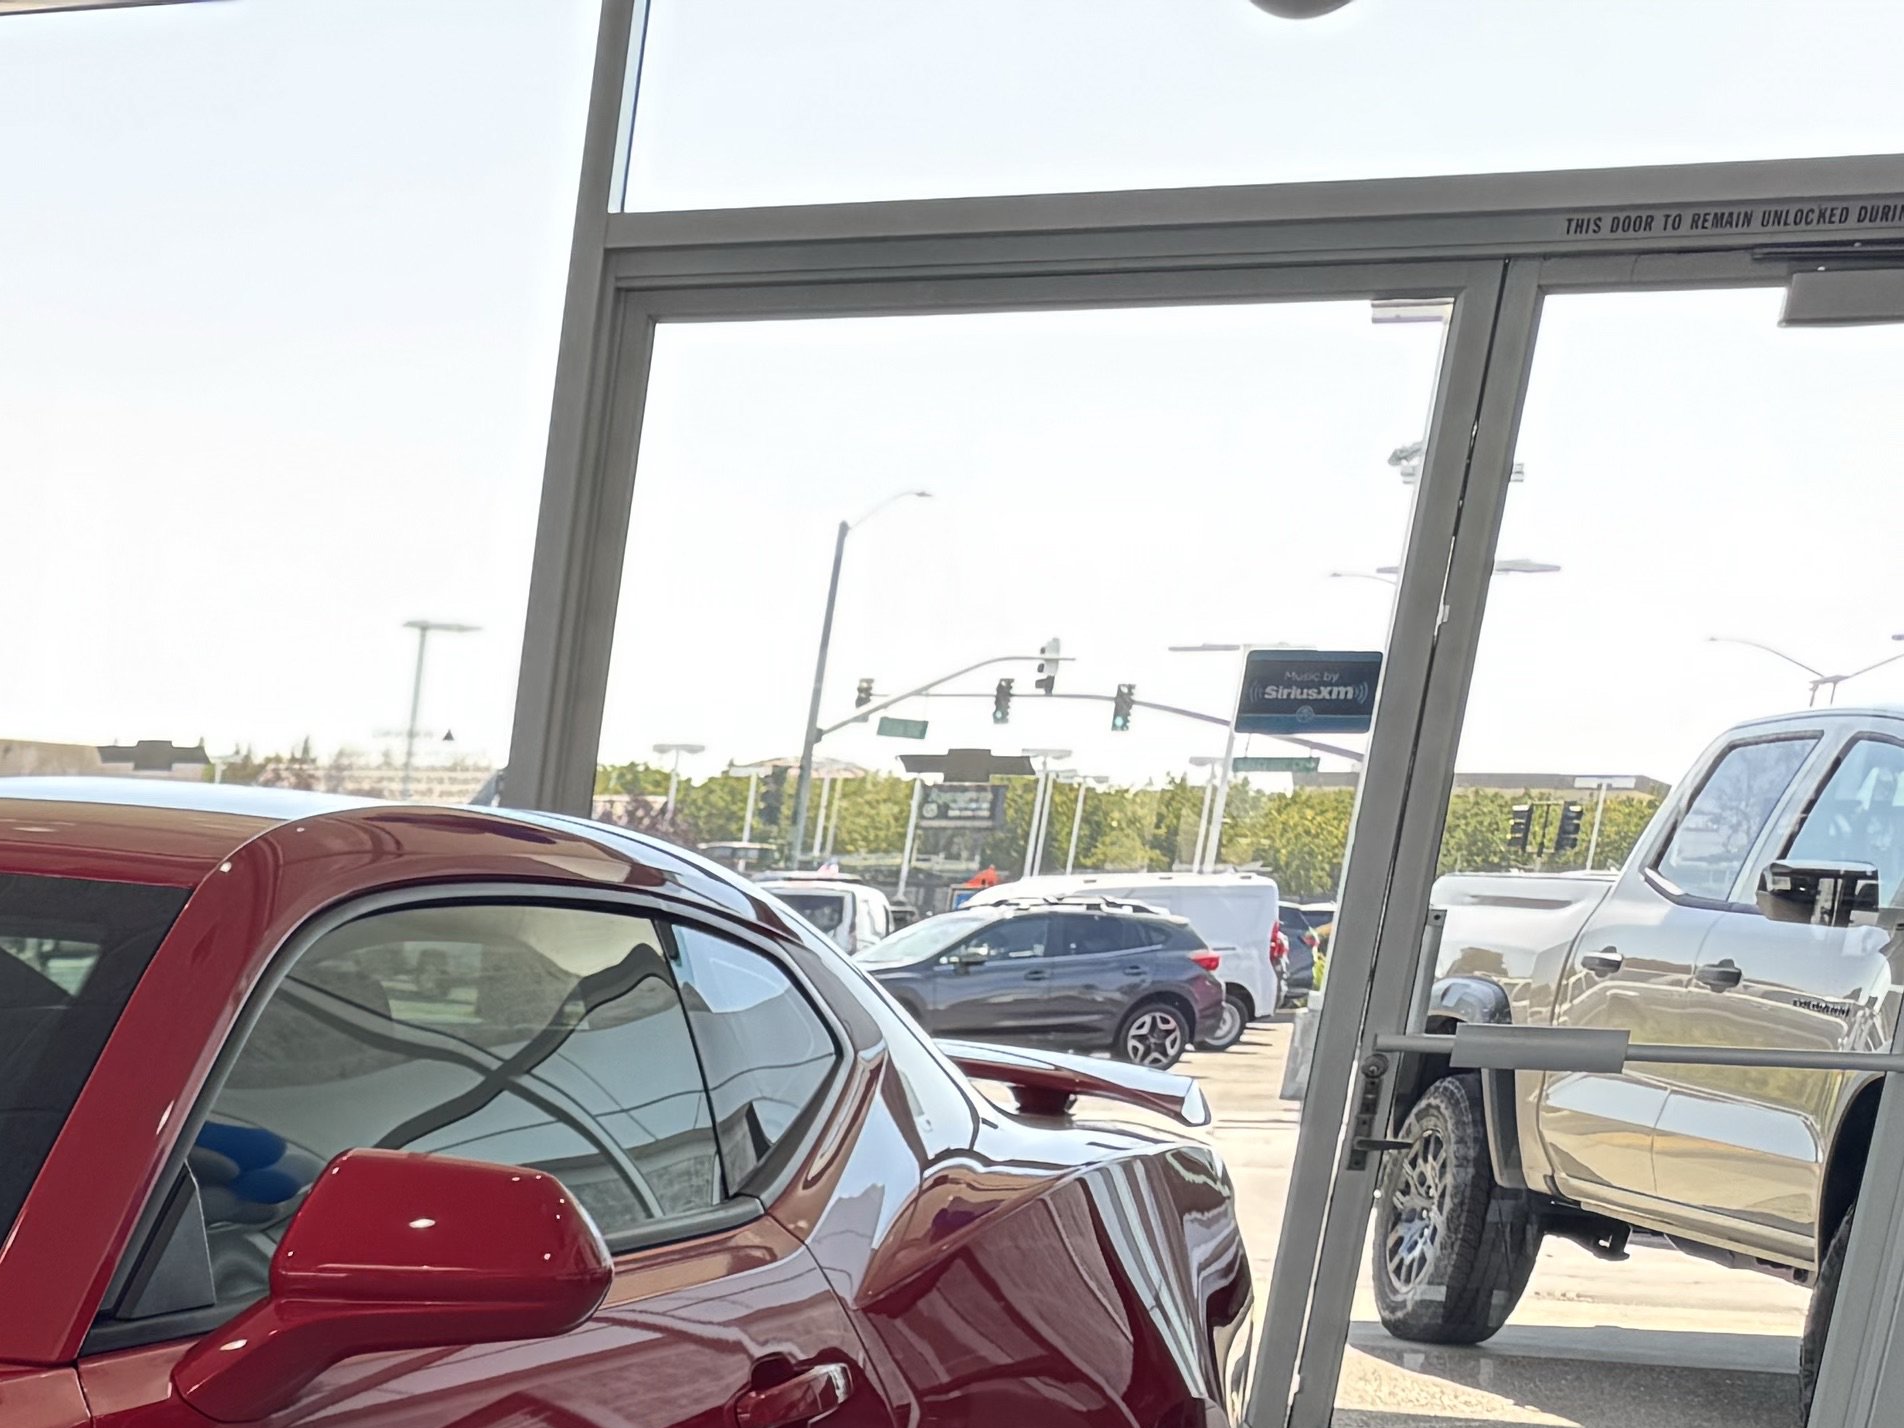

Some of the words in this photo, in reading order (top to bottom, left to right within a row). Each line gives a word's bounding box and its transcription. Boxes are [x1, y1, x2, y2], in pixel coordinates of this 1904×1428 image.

[1566, 217, 1602, 235] THIS
[1610, 214, 1654, 233] DOOR
[1662, 213, 1682, 231] TO
[1691, 209, 1753, 231] REMAIN
[1761, 205, 1849, 228] UNLOCKED
[1284, 671, 1321, 682] Music
[1323, 671, 1340, 684] by
